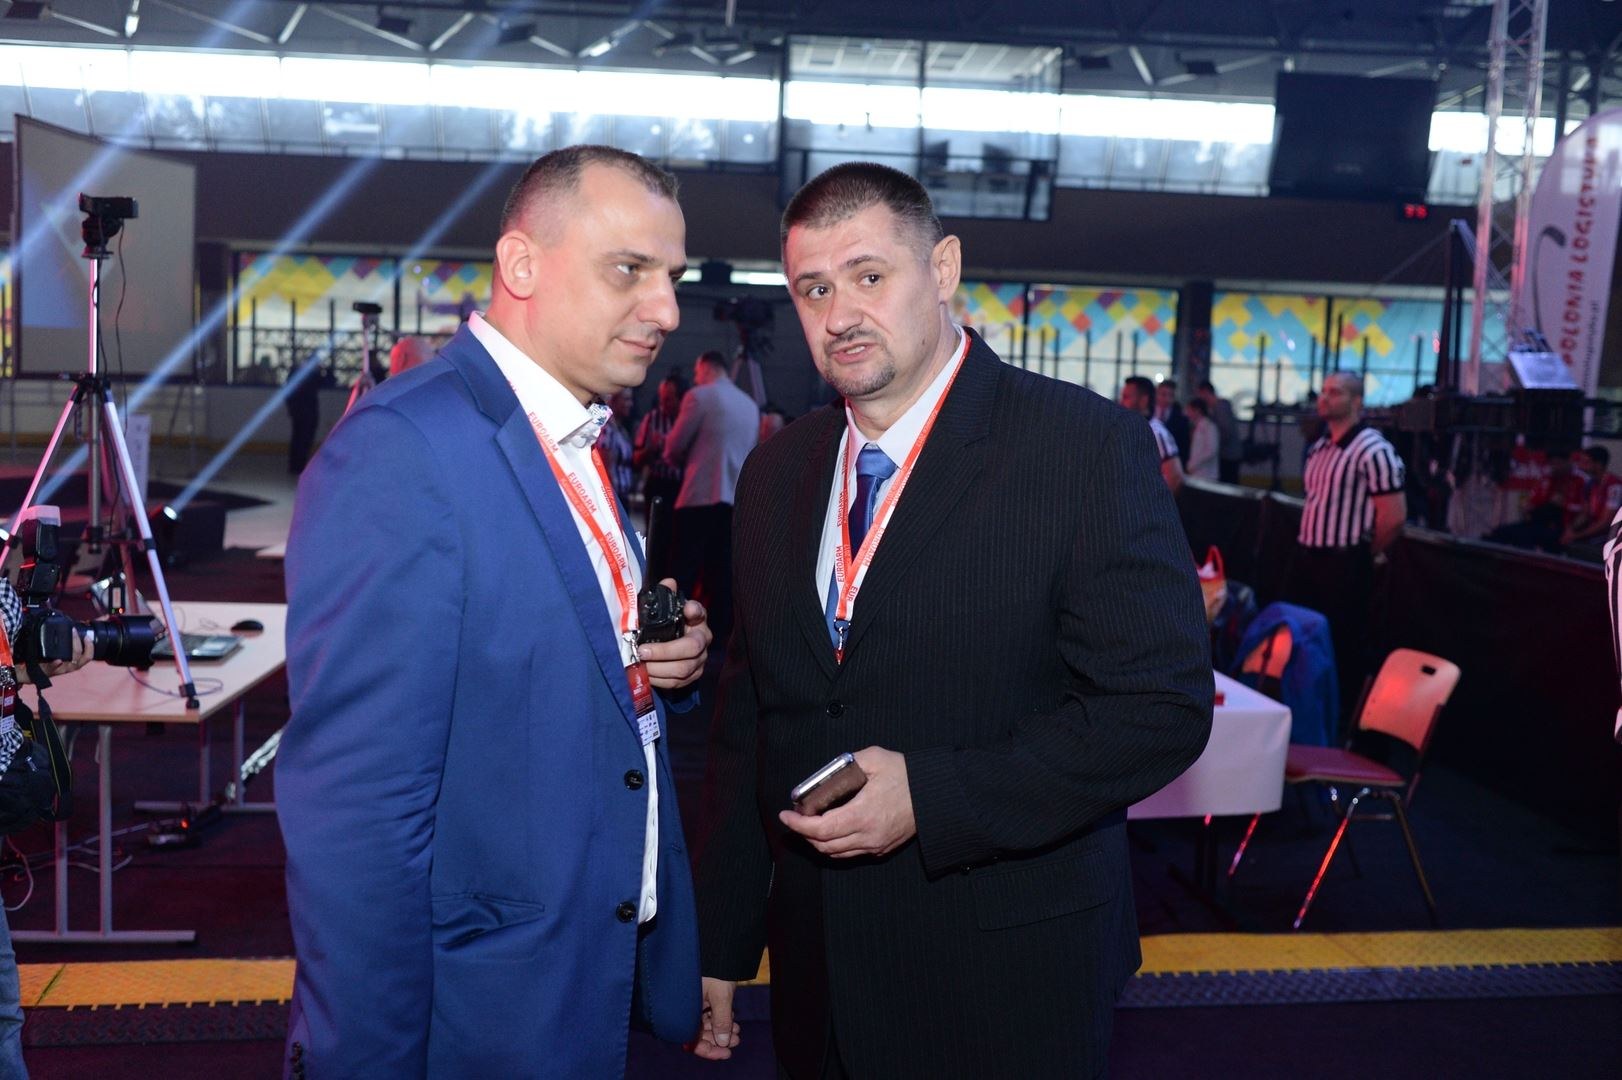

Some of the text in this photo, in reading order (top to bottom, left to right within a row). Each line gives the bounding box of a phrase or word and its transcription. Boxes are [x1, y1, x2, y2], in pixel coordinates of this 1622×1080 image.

[528, 411, 559, 454] EUROARM
[568, 471, 598, 514] EUROARM
[604, 531, 627, 570] EUROARM
[836, 545, 844, 583] EUROARM
[847, 585, 859, 602] EUR
